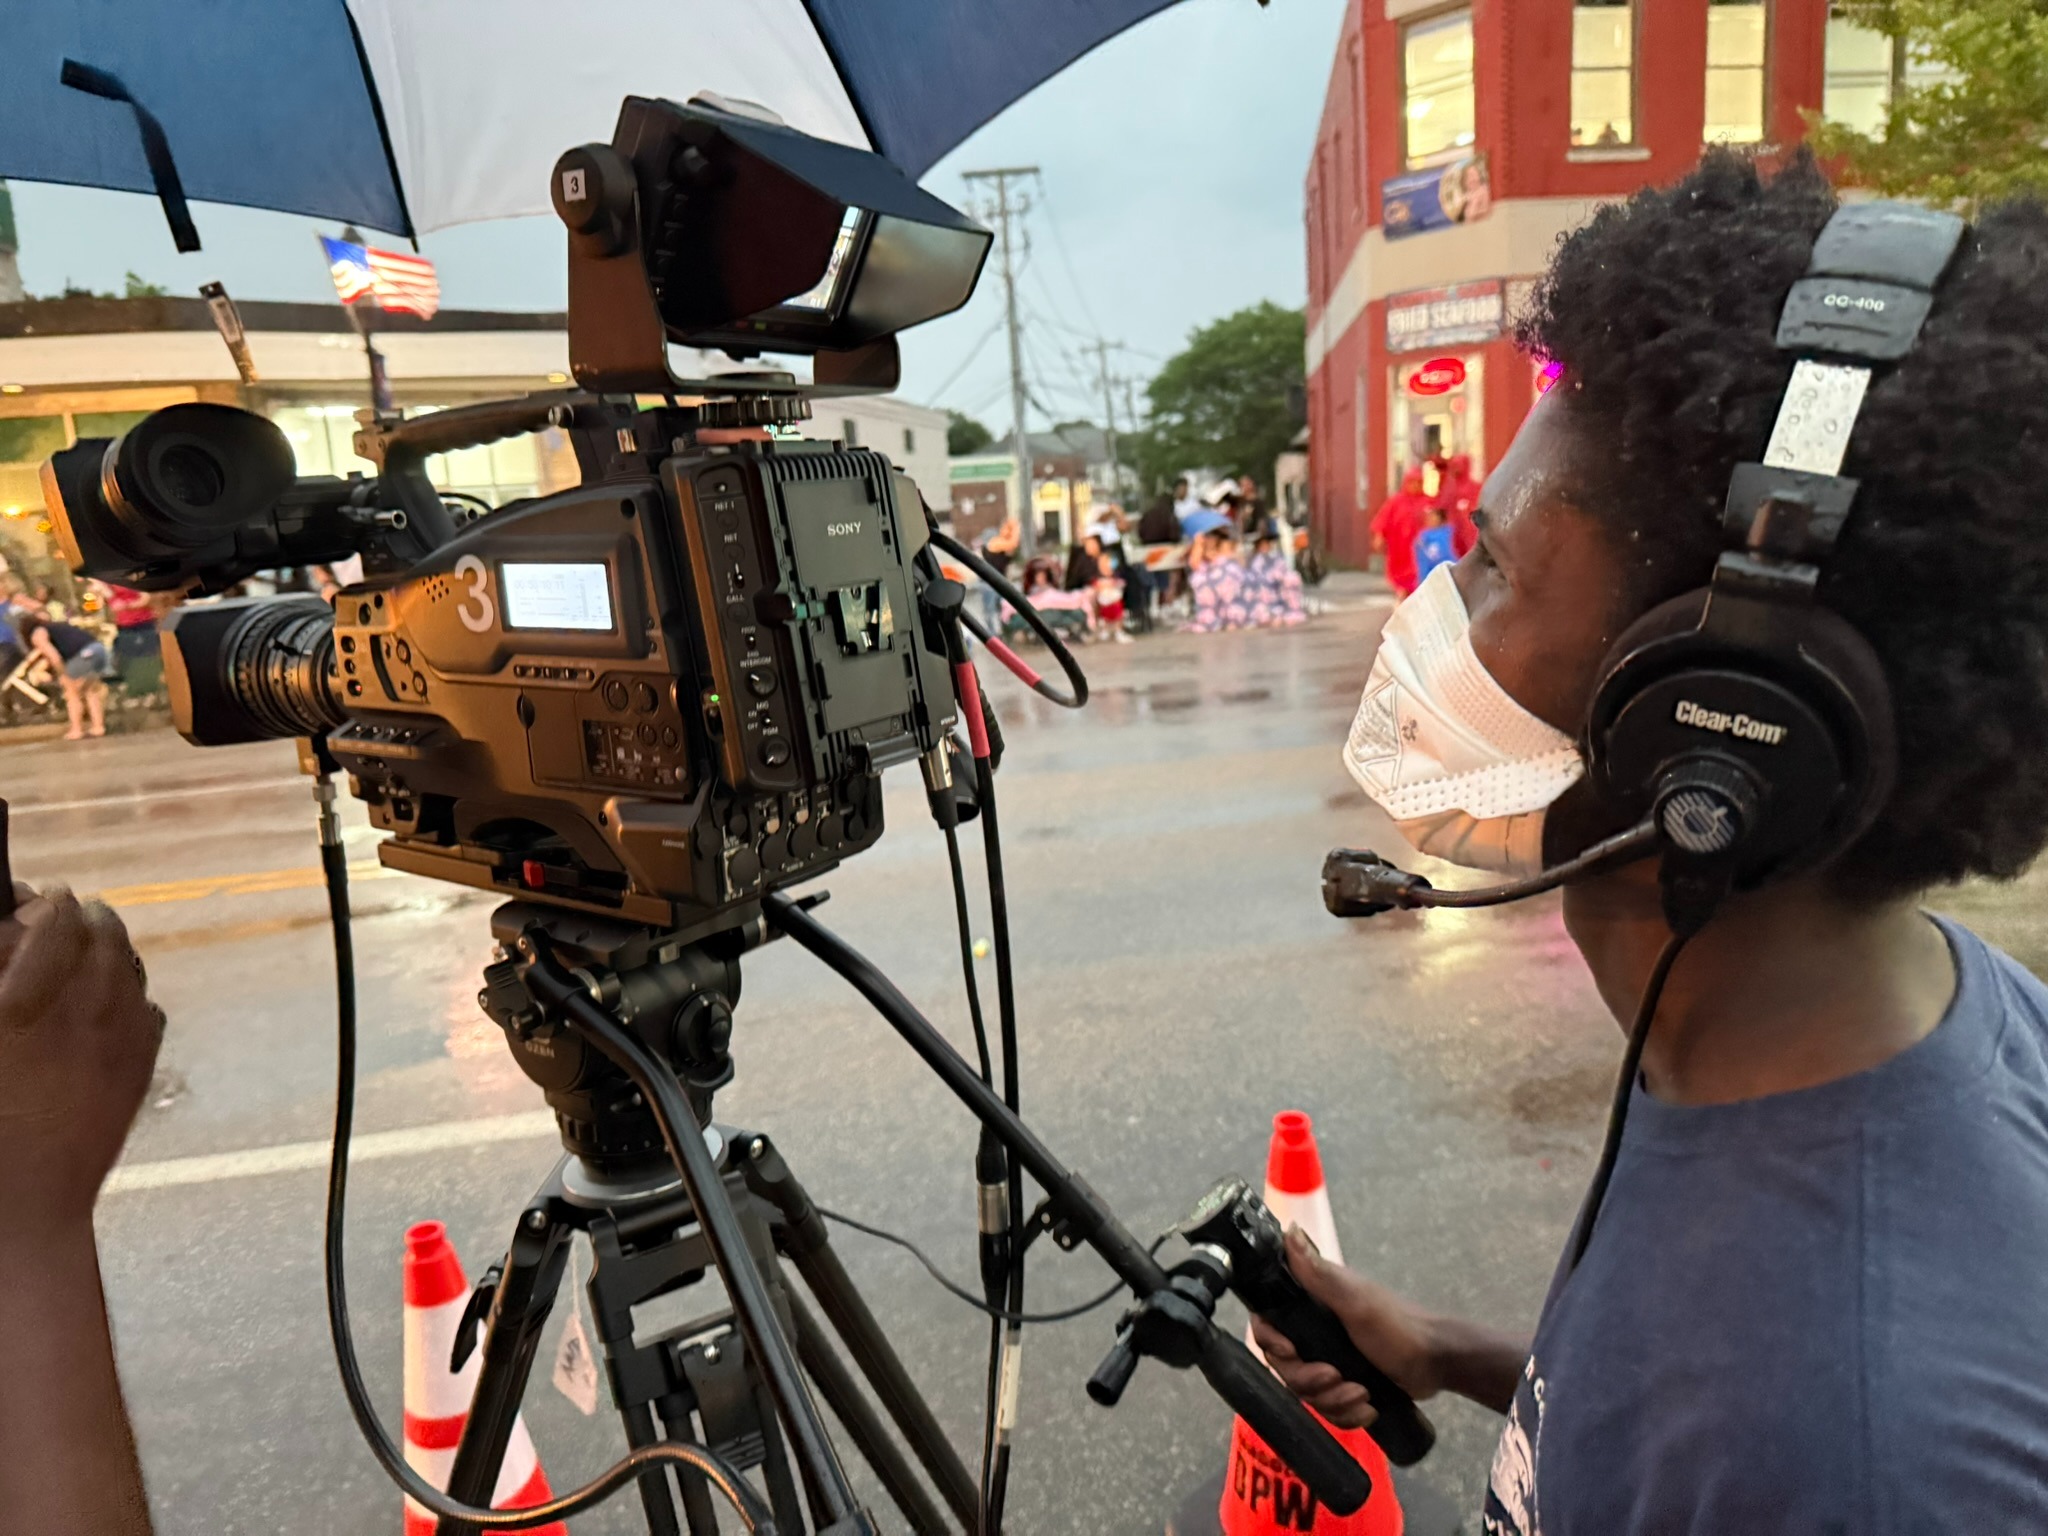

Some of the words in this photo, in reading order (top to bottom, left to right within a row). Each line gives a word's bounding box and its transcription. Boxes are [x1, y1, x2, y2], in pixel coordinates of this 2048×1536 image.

[570, 175, 579, 194] 3
[827, 521, 861, 536] SONY
[454, 554, 494, 633] 3
[1675, 700, 1782, 745] Clear-Com
